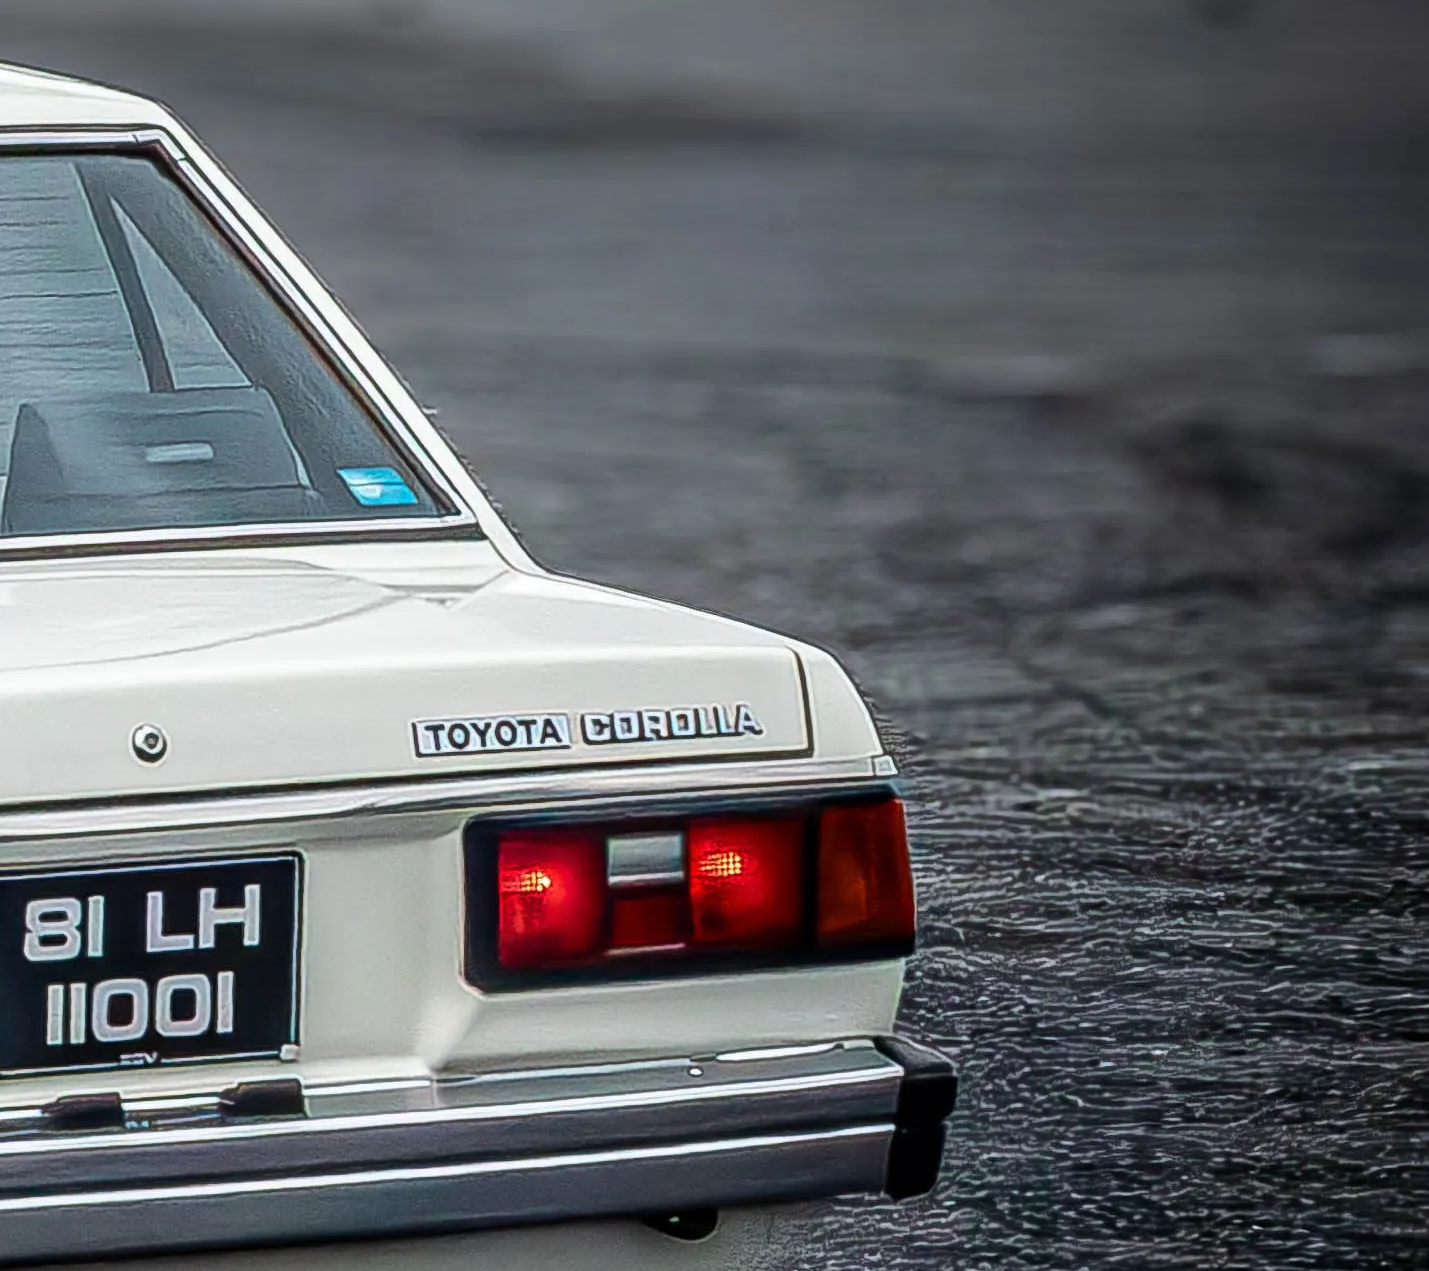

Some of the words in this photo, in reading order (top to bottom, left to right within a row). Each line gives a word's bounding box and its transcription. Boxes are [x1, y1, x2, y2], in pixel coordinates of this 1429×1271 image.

[422, 716, 564, 752] TOYOTA
[580, 705, 765, 745] COROLLA
[23, 895, 105, 962] 81
[146, 883, 261, 953] LH
[46, 970, 234, 1046] 11001
